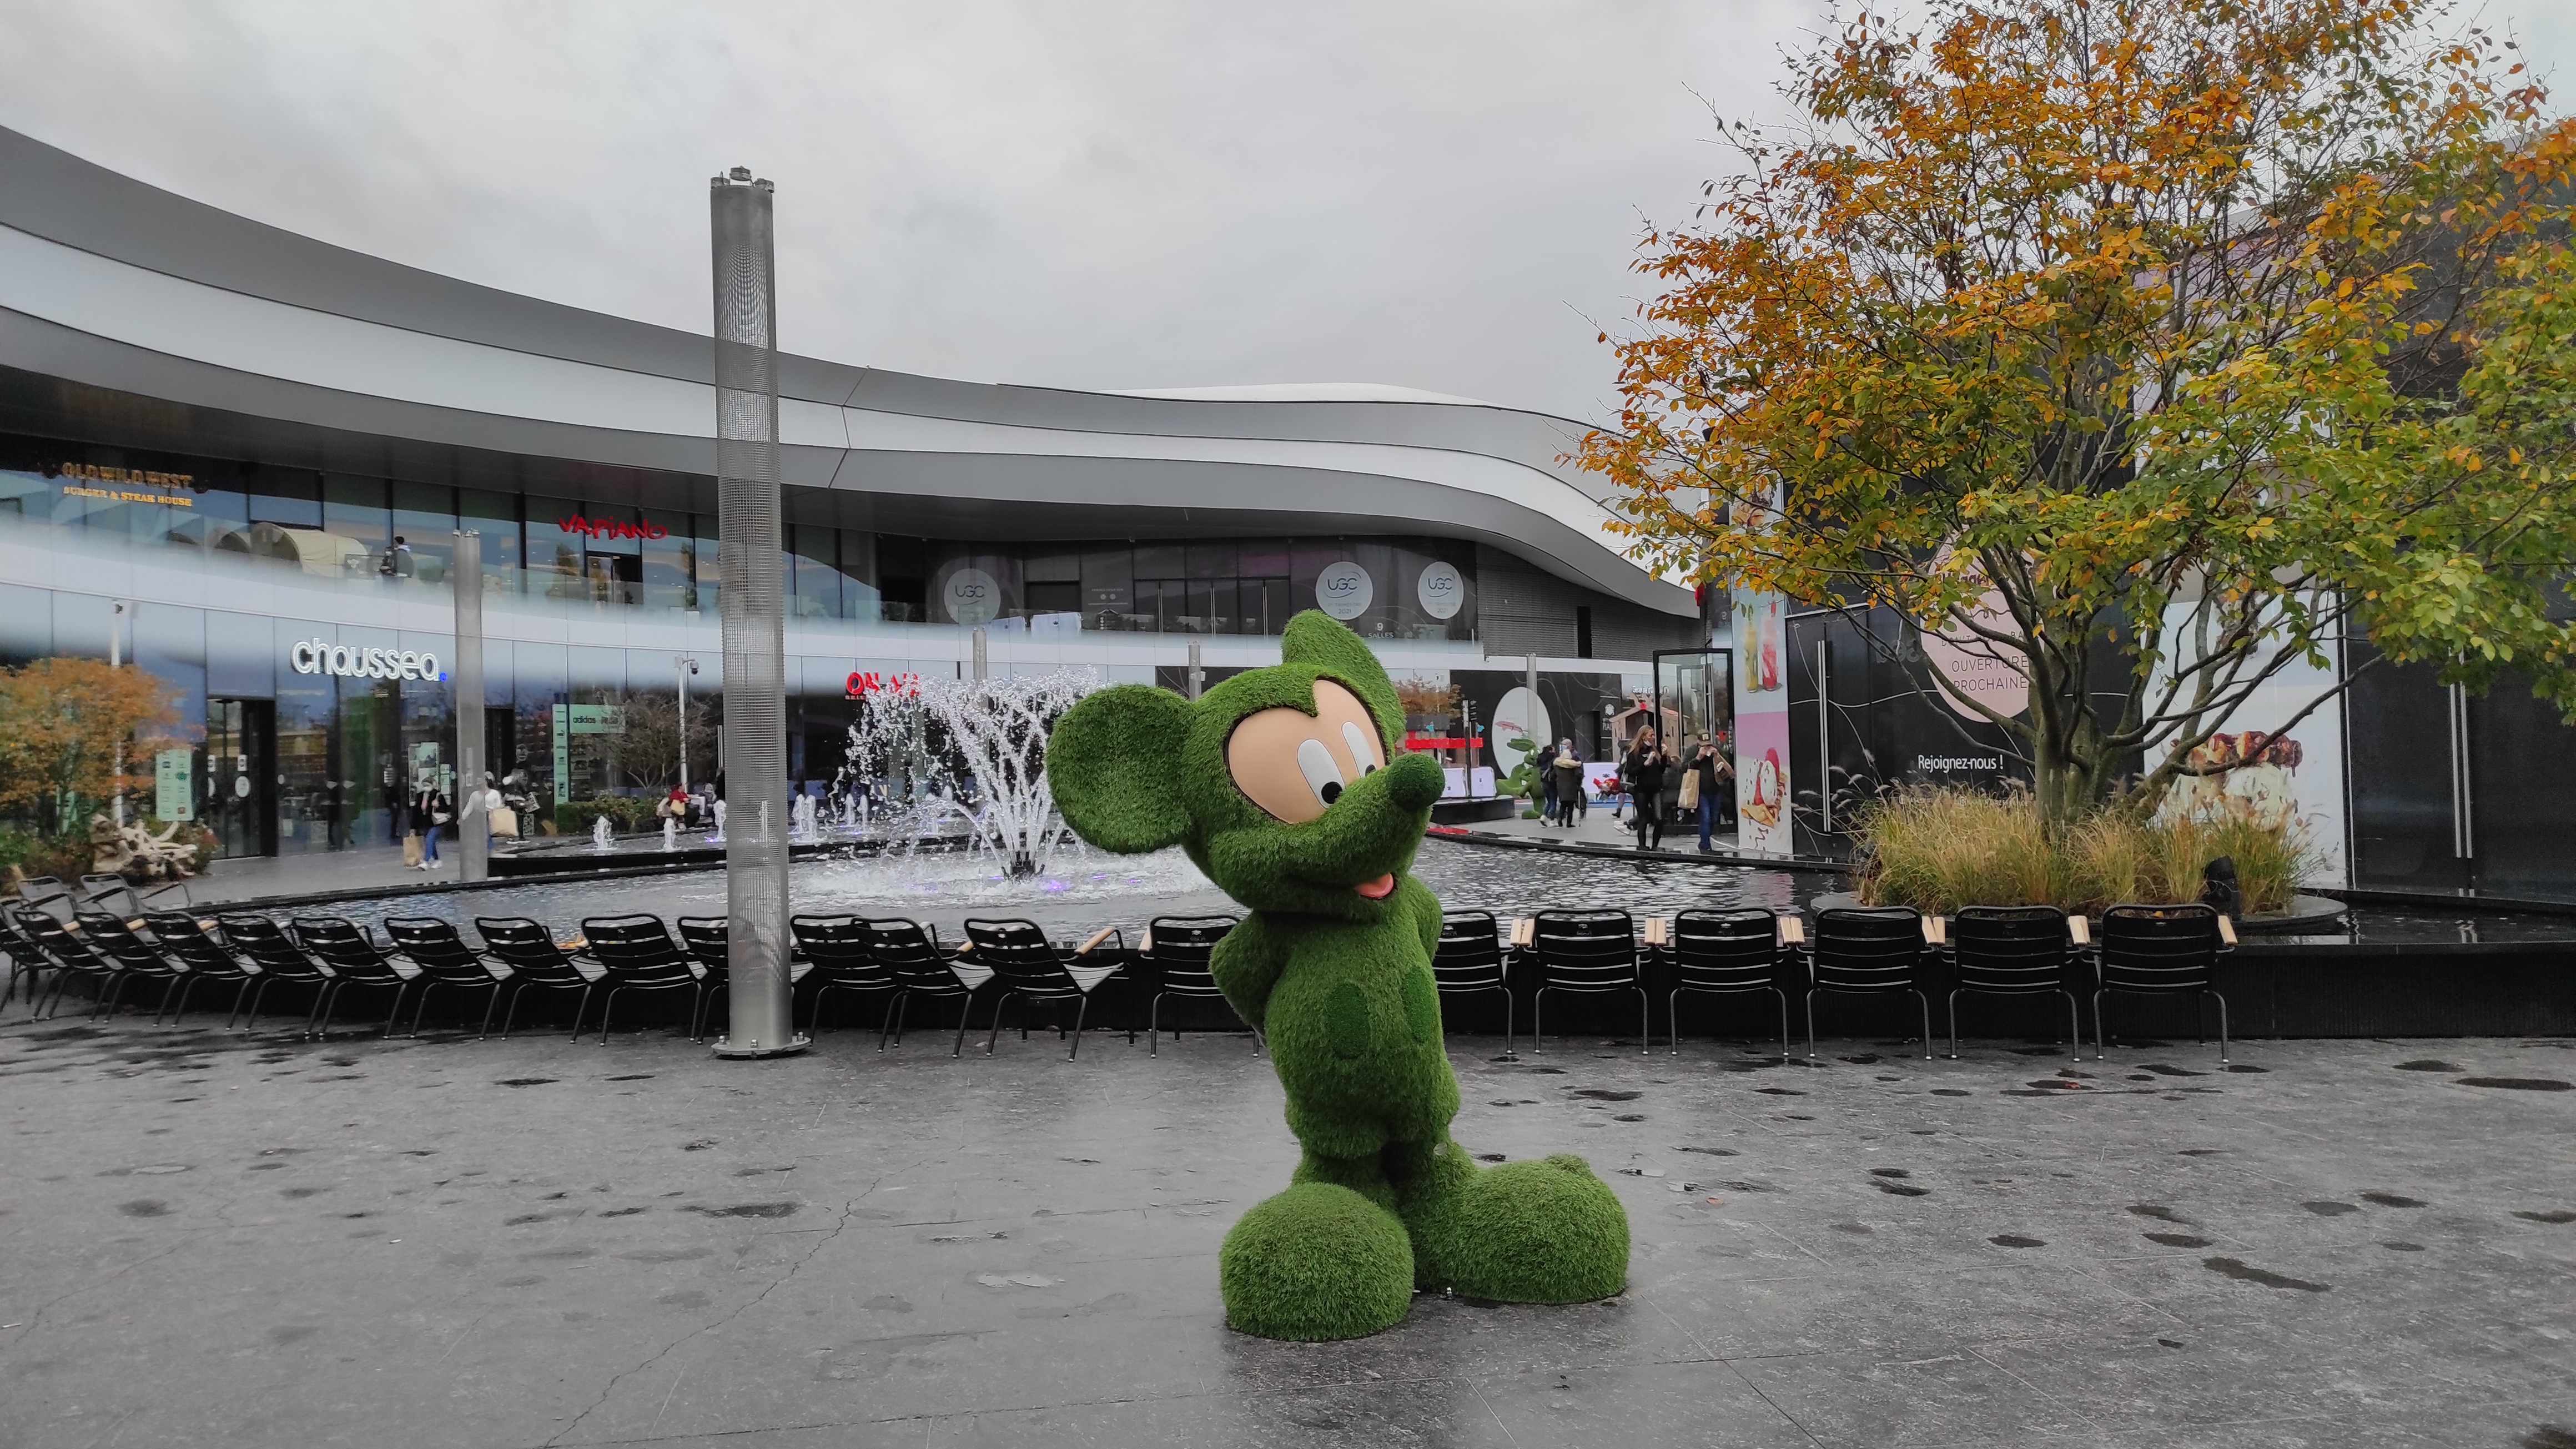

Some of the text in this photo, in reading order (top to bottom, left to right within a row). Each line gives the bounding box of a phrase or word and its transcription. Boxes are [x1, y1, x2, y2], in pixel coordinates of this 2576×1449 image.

[120, 492, 155, 503] STEAK
[158, 495, 193, 507] HOUSE
[955, 585, 984, 597] UGC
[1327, 577, 1357, 590] UGC
[1428, 578, 1452, 590] UGC
[1377, 622, 1383, 631] 9
[1951, 655, 2029, 672] OUVERTURE
[846, 671, 879, 695] ON
[1954, 676, 2027, 692] PROCHAINE
[1918, 754, 1997, 773] Rejoignez-nous
